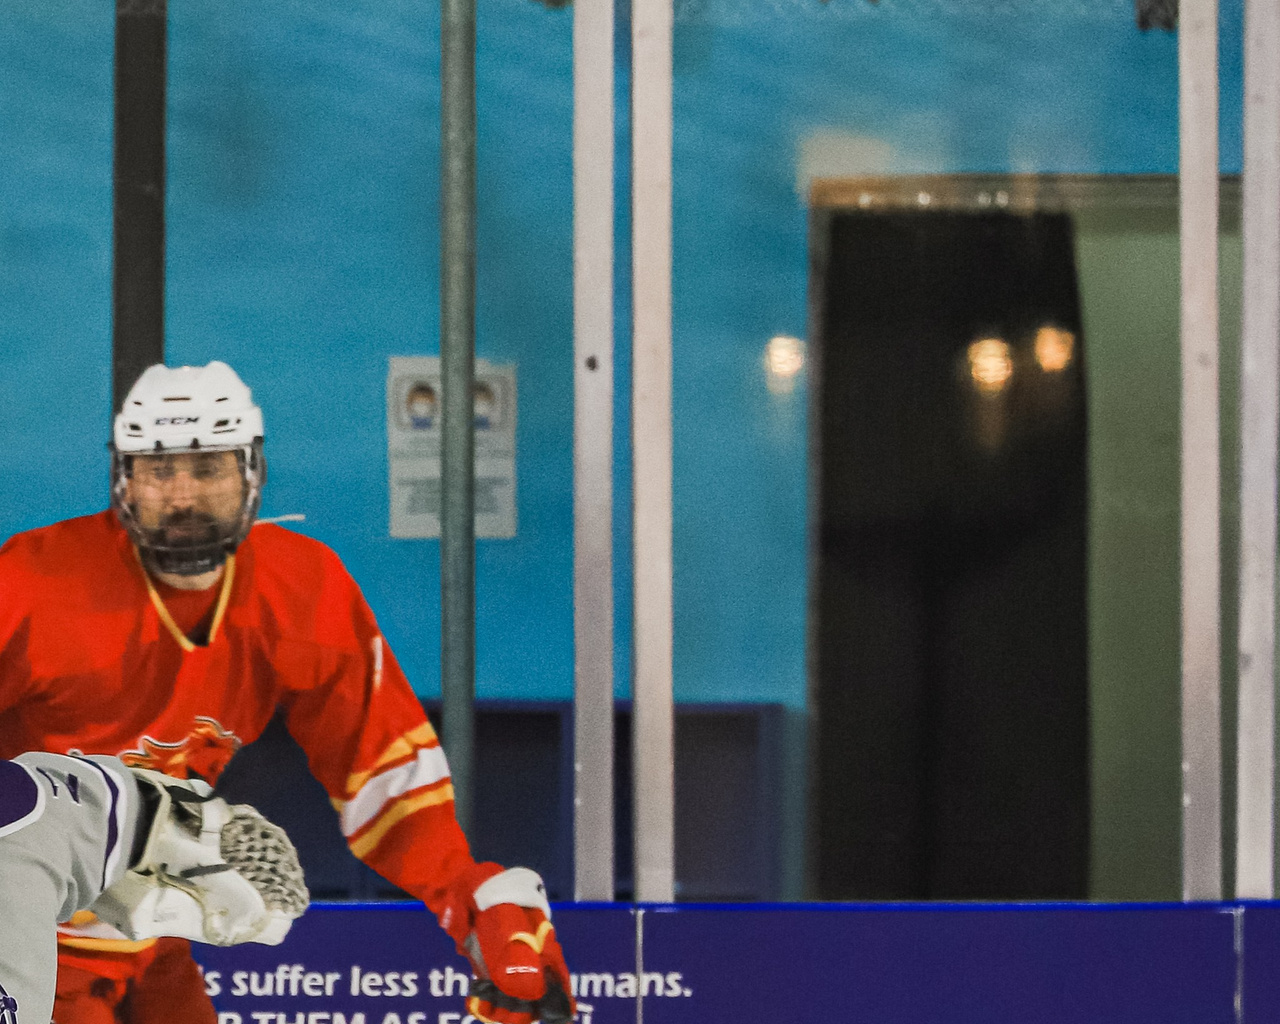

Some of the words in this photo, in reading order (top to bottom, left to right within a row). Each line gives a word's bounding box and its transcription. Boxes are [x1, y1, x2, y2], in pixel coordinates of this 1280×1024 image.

[231, 964, 341, 997] suffer
[350, 965, 419, 997] less
[428, 966, 477, 998] th
[570, 972, 693, 998] mans.
